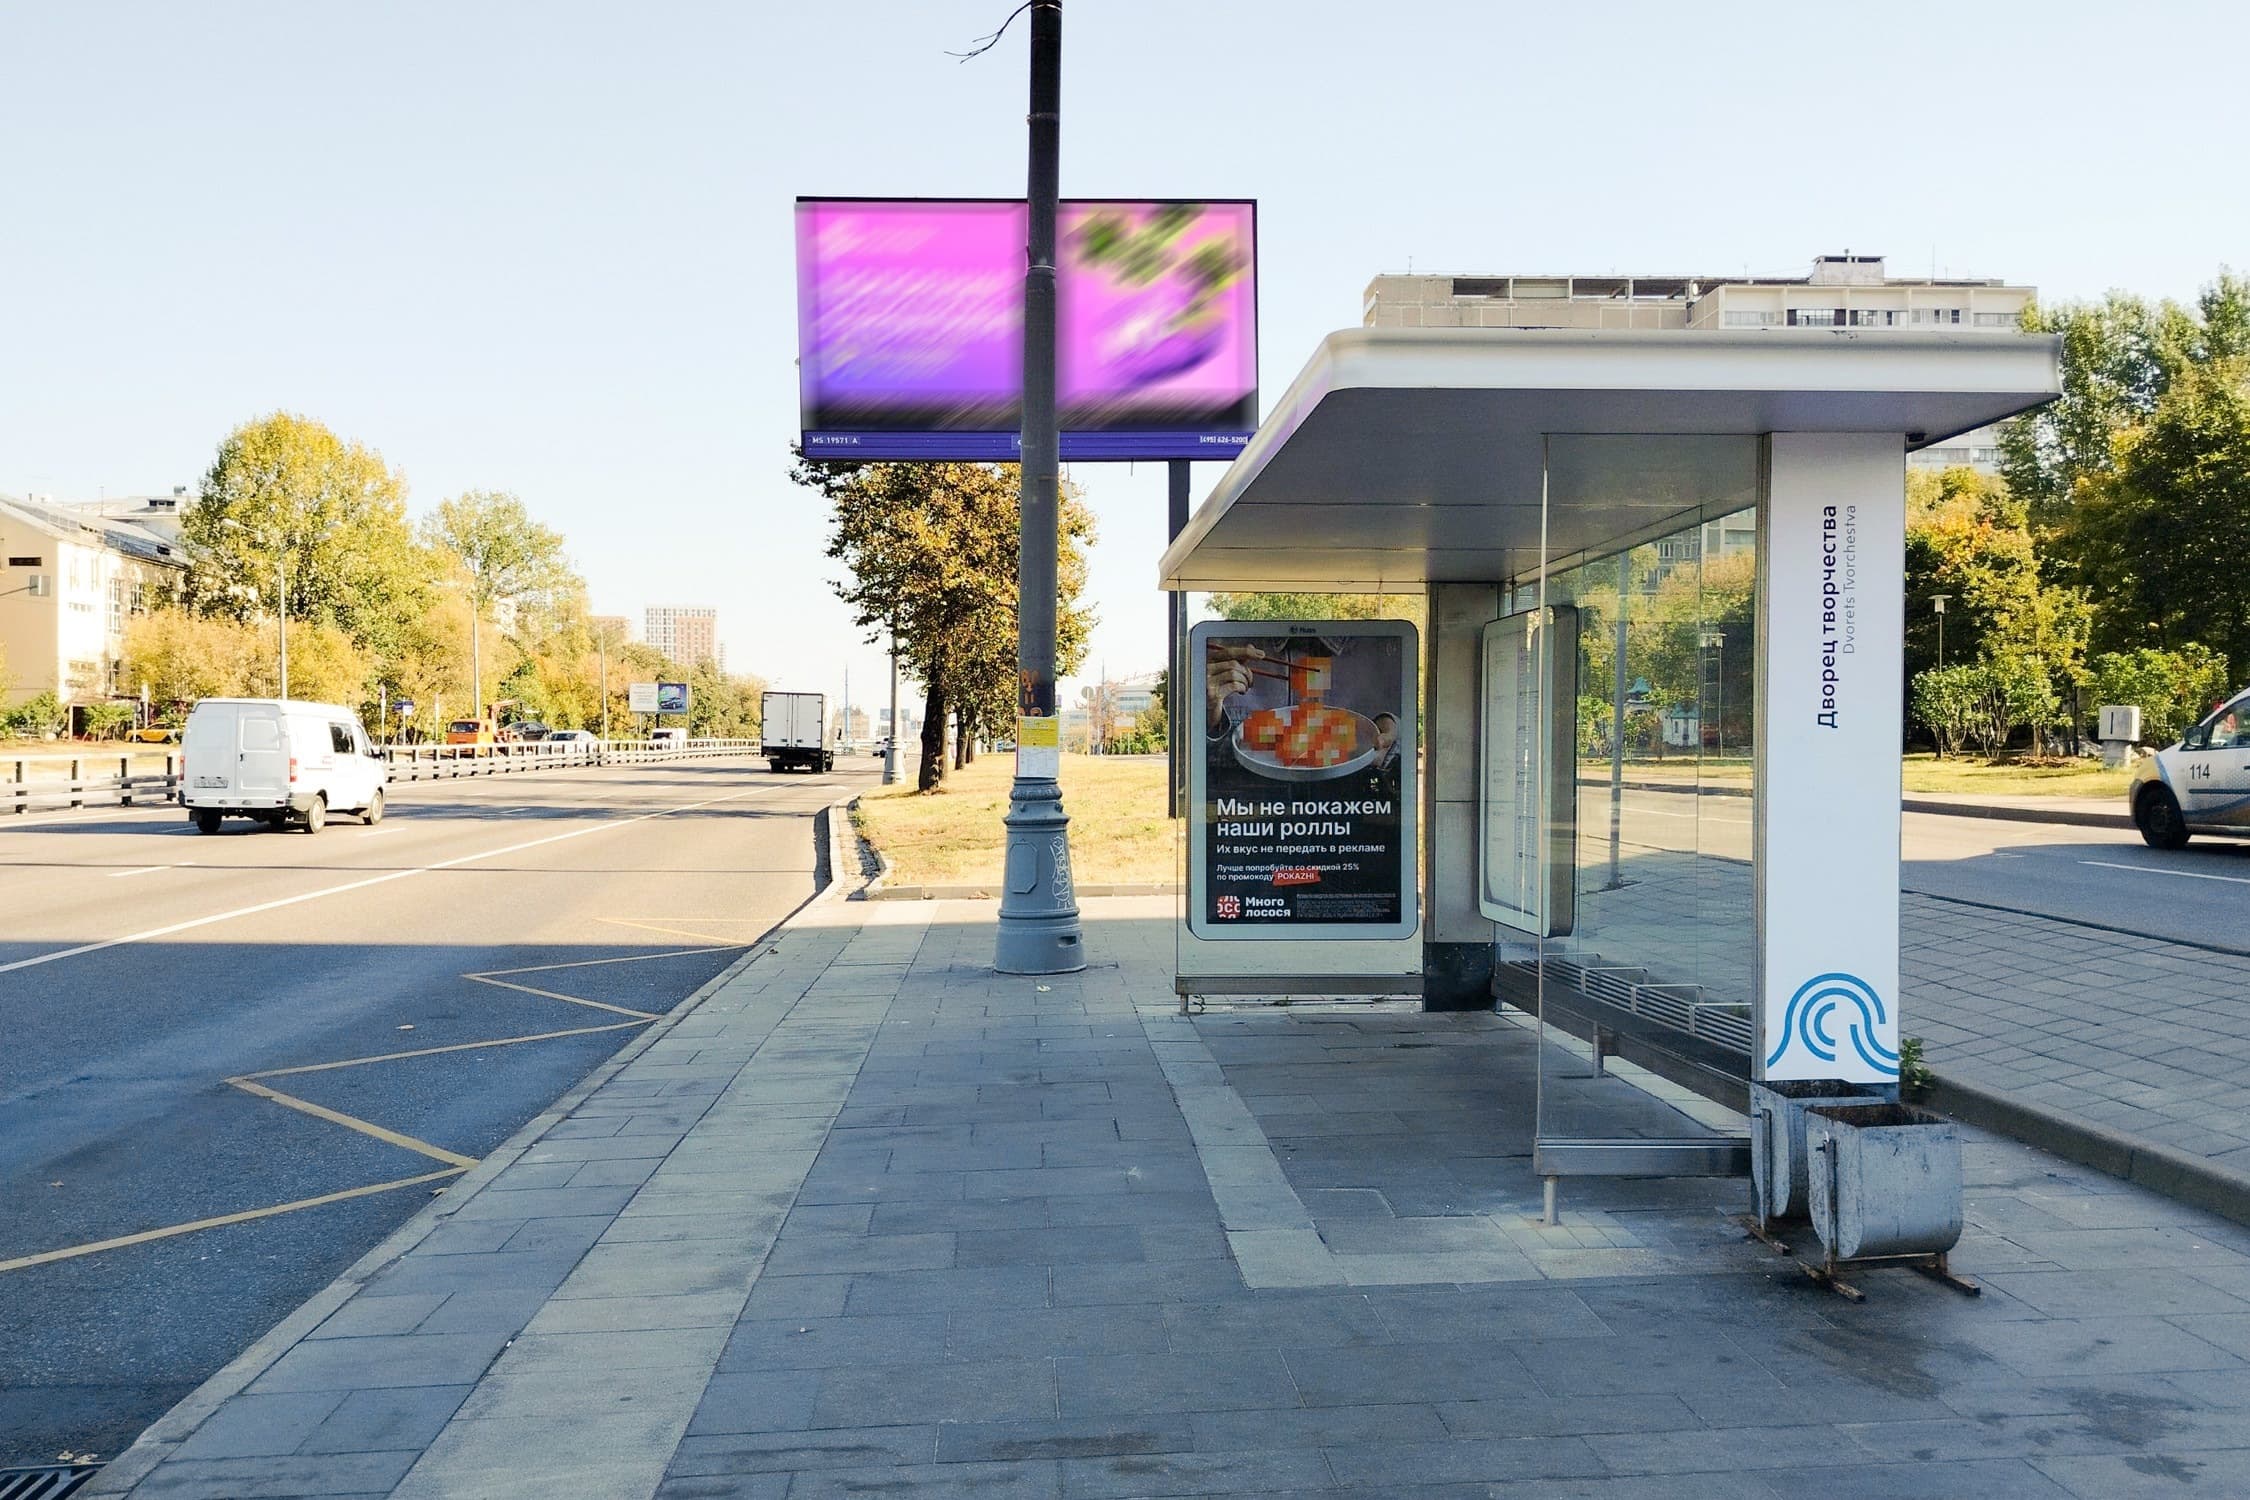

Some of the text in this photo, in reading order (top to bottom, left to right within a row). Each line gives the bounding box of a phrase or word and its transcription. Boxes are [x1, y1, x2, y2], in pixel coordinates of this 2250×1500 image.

[1843, 505, 1856, 654] Dvorets Tvorchestva
[1817, 505, 1840, 728] Дворец творчества
[2189, 763, 2210, 780] 114
[1217, 798, 1391, 816] Мы не покажем
[1217, 821, 1350, 840] наши роллы
[1216, 844, 1386, 855] Их вкус не передать в рекламе
[1216, 864, 1244, 873] Лучше
[1245, 864, 1295, 873] попробуйте
[1307, 863, 1341, 872] скидкой
[1342, 863, 1360, 871] 25%
[1228, 873, 1274, 882] промокоду
[1277, 872, 1315, 880] POKAZHI
[1245, 896, 1285, 907] Много
[1245, 909, 1291, 917] лосося
